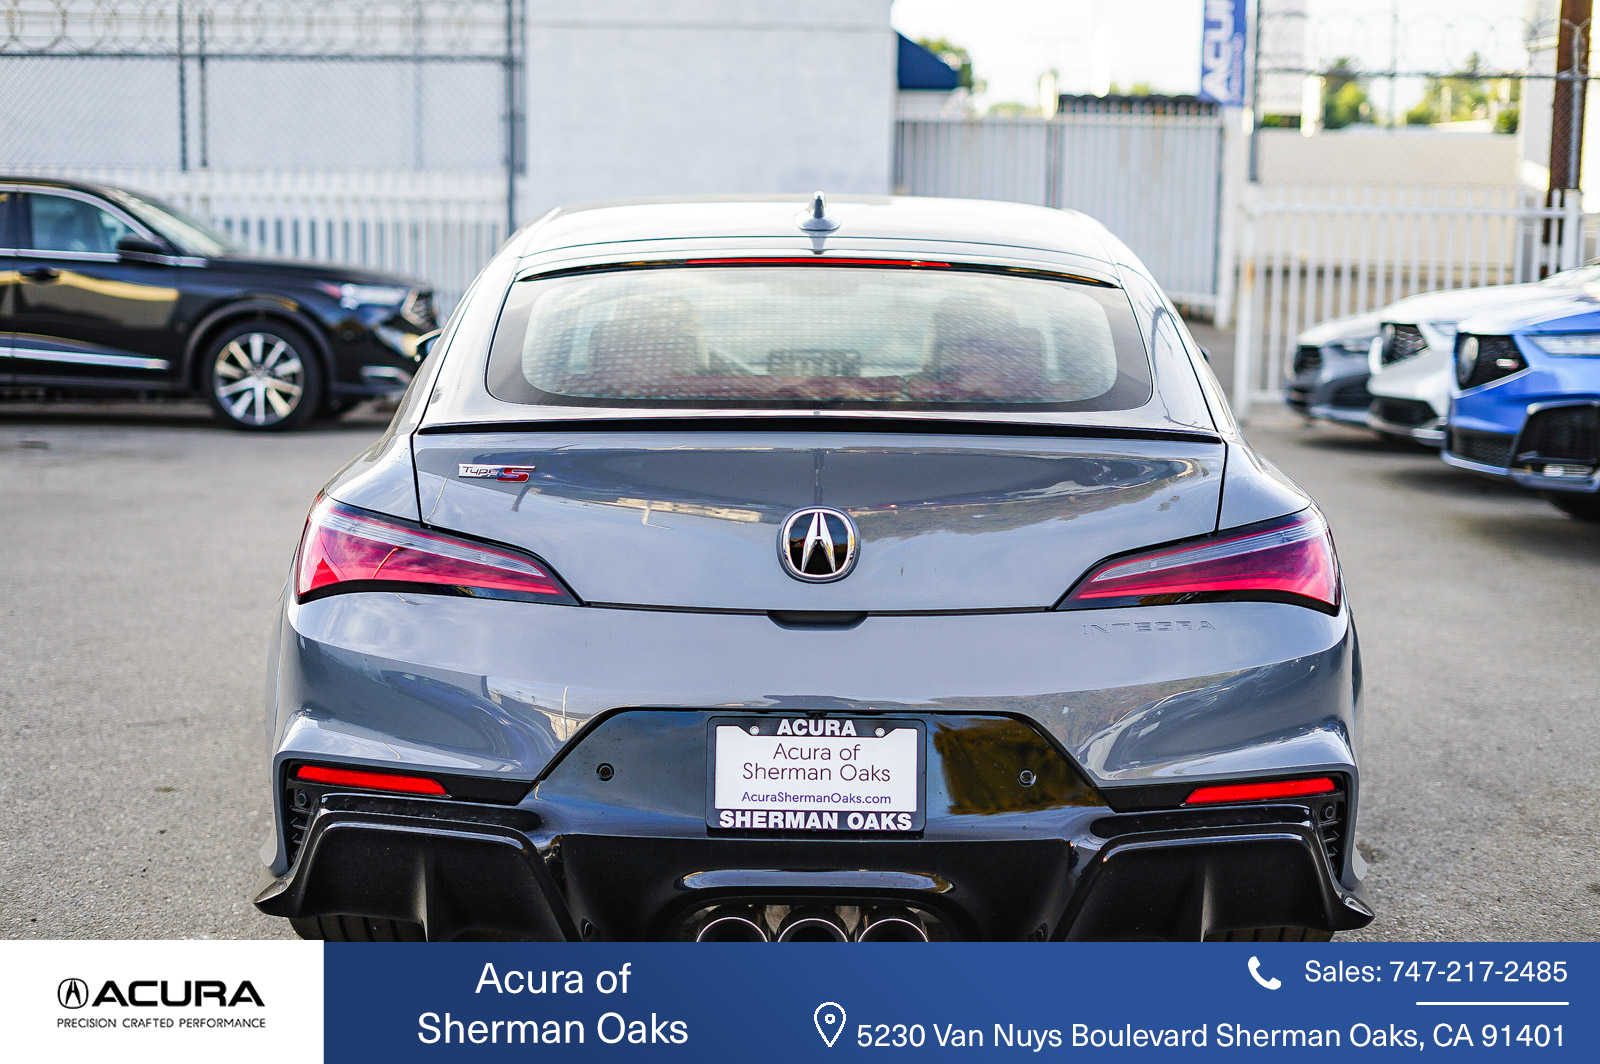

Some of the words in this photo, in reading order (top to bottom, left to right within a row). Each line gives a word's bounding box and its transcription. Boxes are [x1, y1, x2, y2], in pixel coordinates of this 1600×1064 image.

[1079, 619, 1217, 639] INTEGRA
[776, 718, 857, 737] ACURA
[772, 742, 832, 761] Acura
[838, 743, 862, 761] of
[742, 761, 832, 781] Sherman
[839, 763, 891, 783] Oaks
[740, 790, 892, 805] AcuraShermanOaks.com
[718, 809, 839, 830] SHERMAN
[846, 812, 913, 831] OAKS
